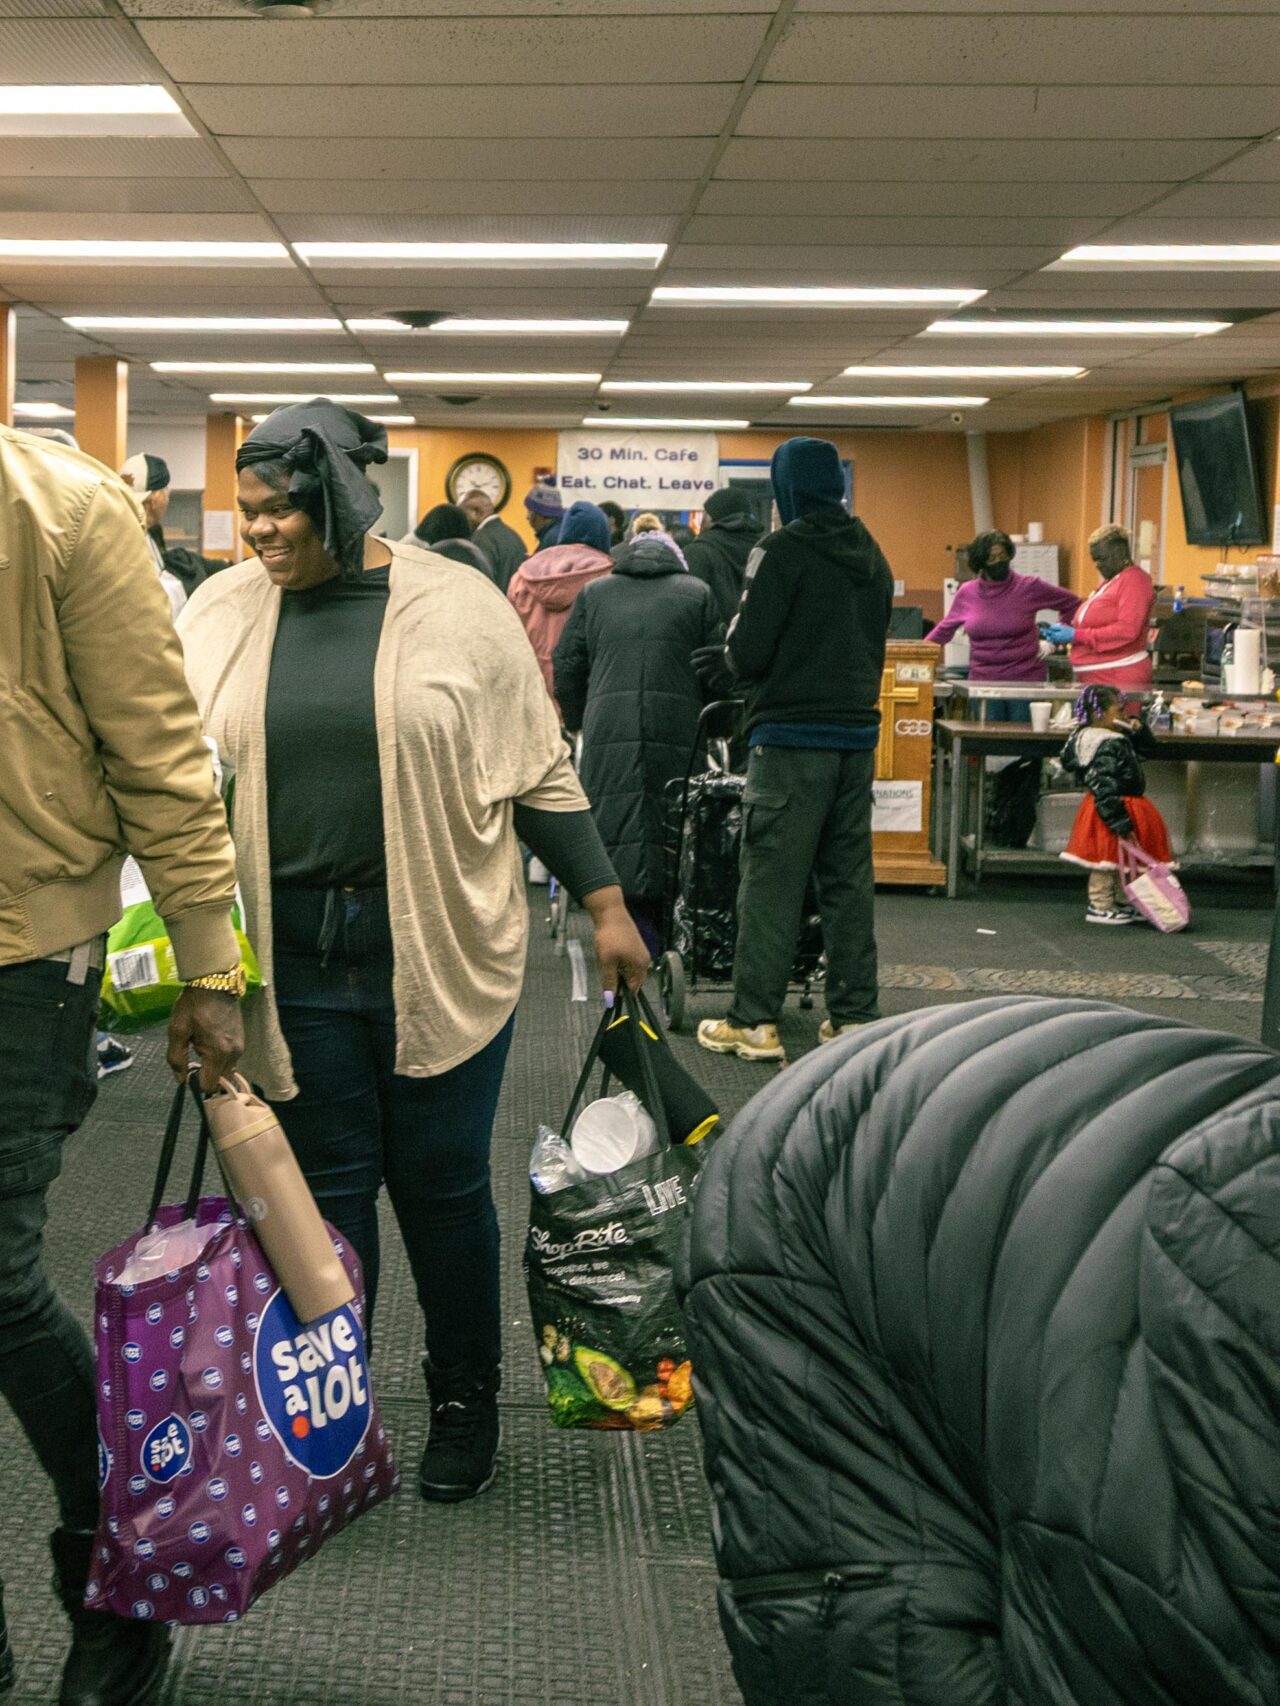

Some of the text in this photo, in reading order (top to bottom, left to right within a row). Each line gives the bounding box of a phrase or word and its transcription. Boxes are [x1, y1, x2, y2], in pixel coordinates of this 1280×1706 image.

[577, 447, 699, 462] 30 Min. Cafe
[561, 475, 715, 490] Eat. Chat. Leave
[531, 1221, 628, 1264] ShopRite
[270, 1314, 358, 1382] save
[282, 1384, 309, 1416] a
